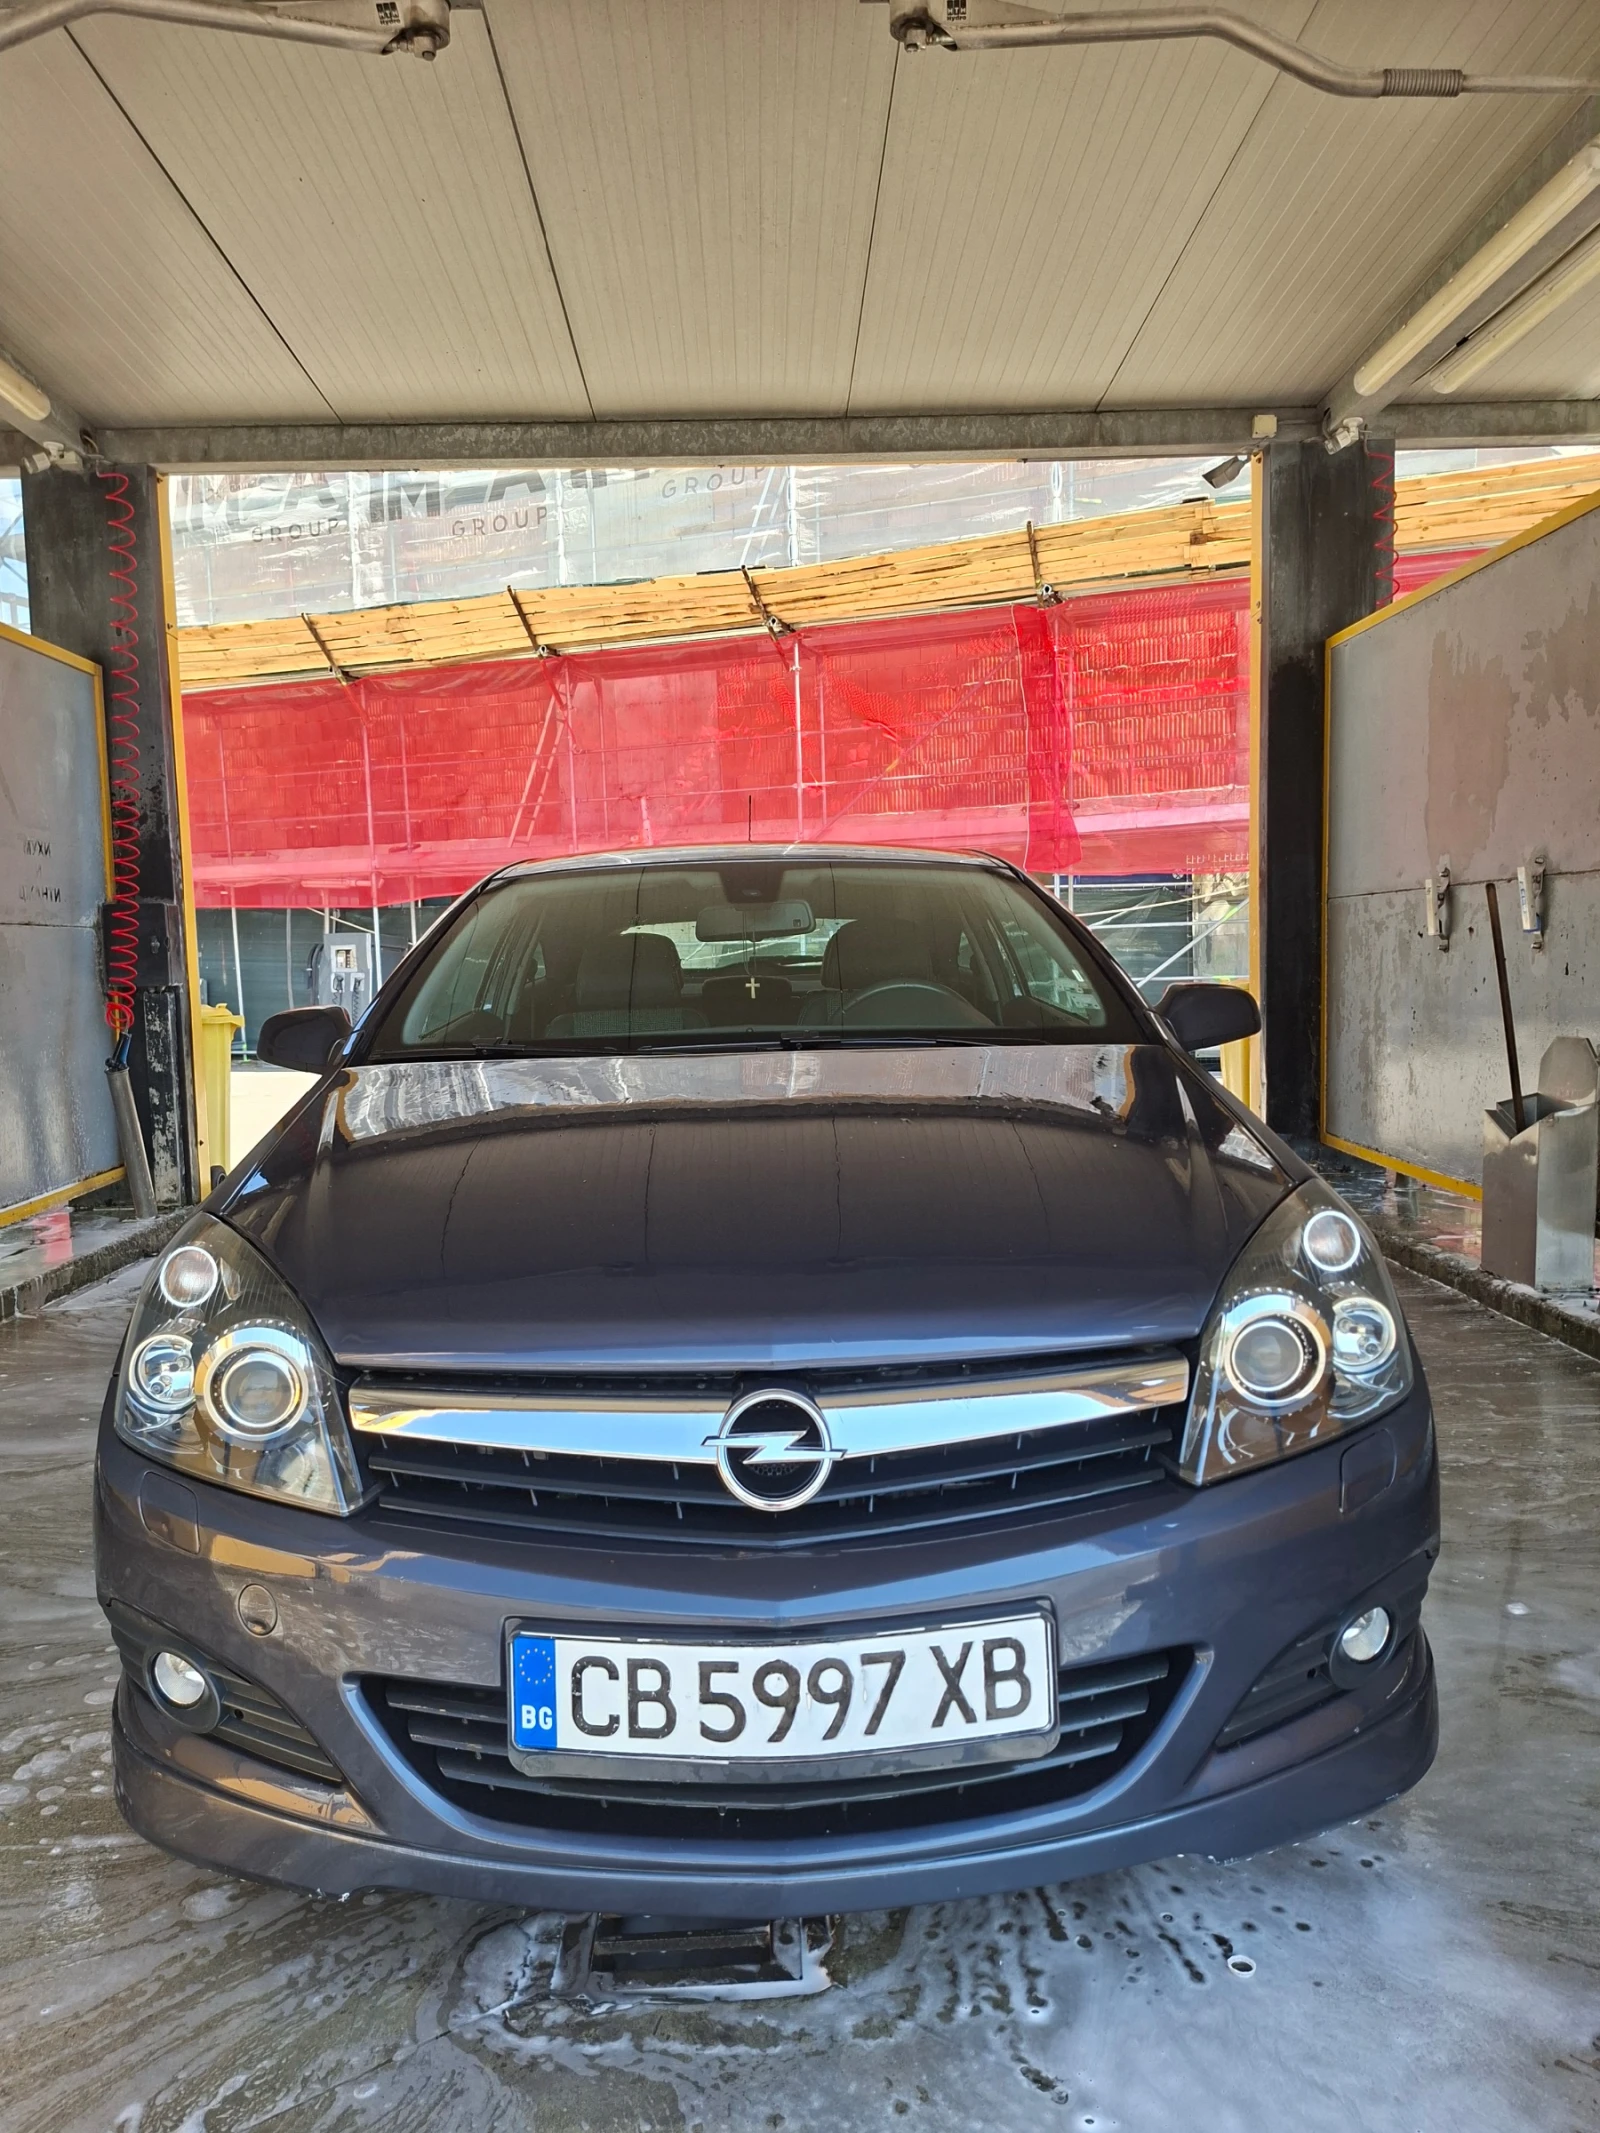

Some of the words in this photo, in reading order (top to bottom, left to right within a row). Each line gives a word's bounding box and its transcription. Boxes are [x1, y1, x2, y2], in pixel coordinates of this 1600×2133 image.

[661, 466, 767, 499] GROUP
[251, 517, 340, 543] GROUP
[452, 506, 548, 537] GROUP
[571, 1655, 677, 1740] CB
[699, 1650, 906, 1744] 5997
[929, 1636, 1032, 1729] XB
[521, 1704, 553, 1731] BG
